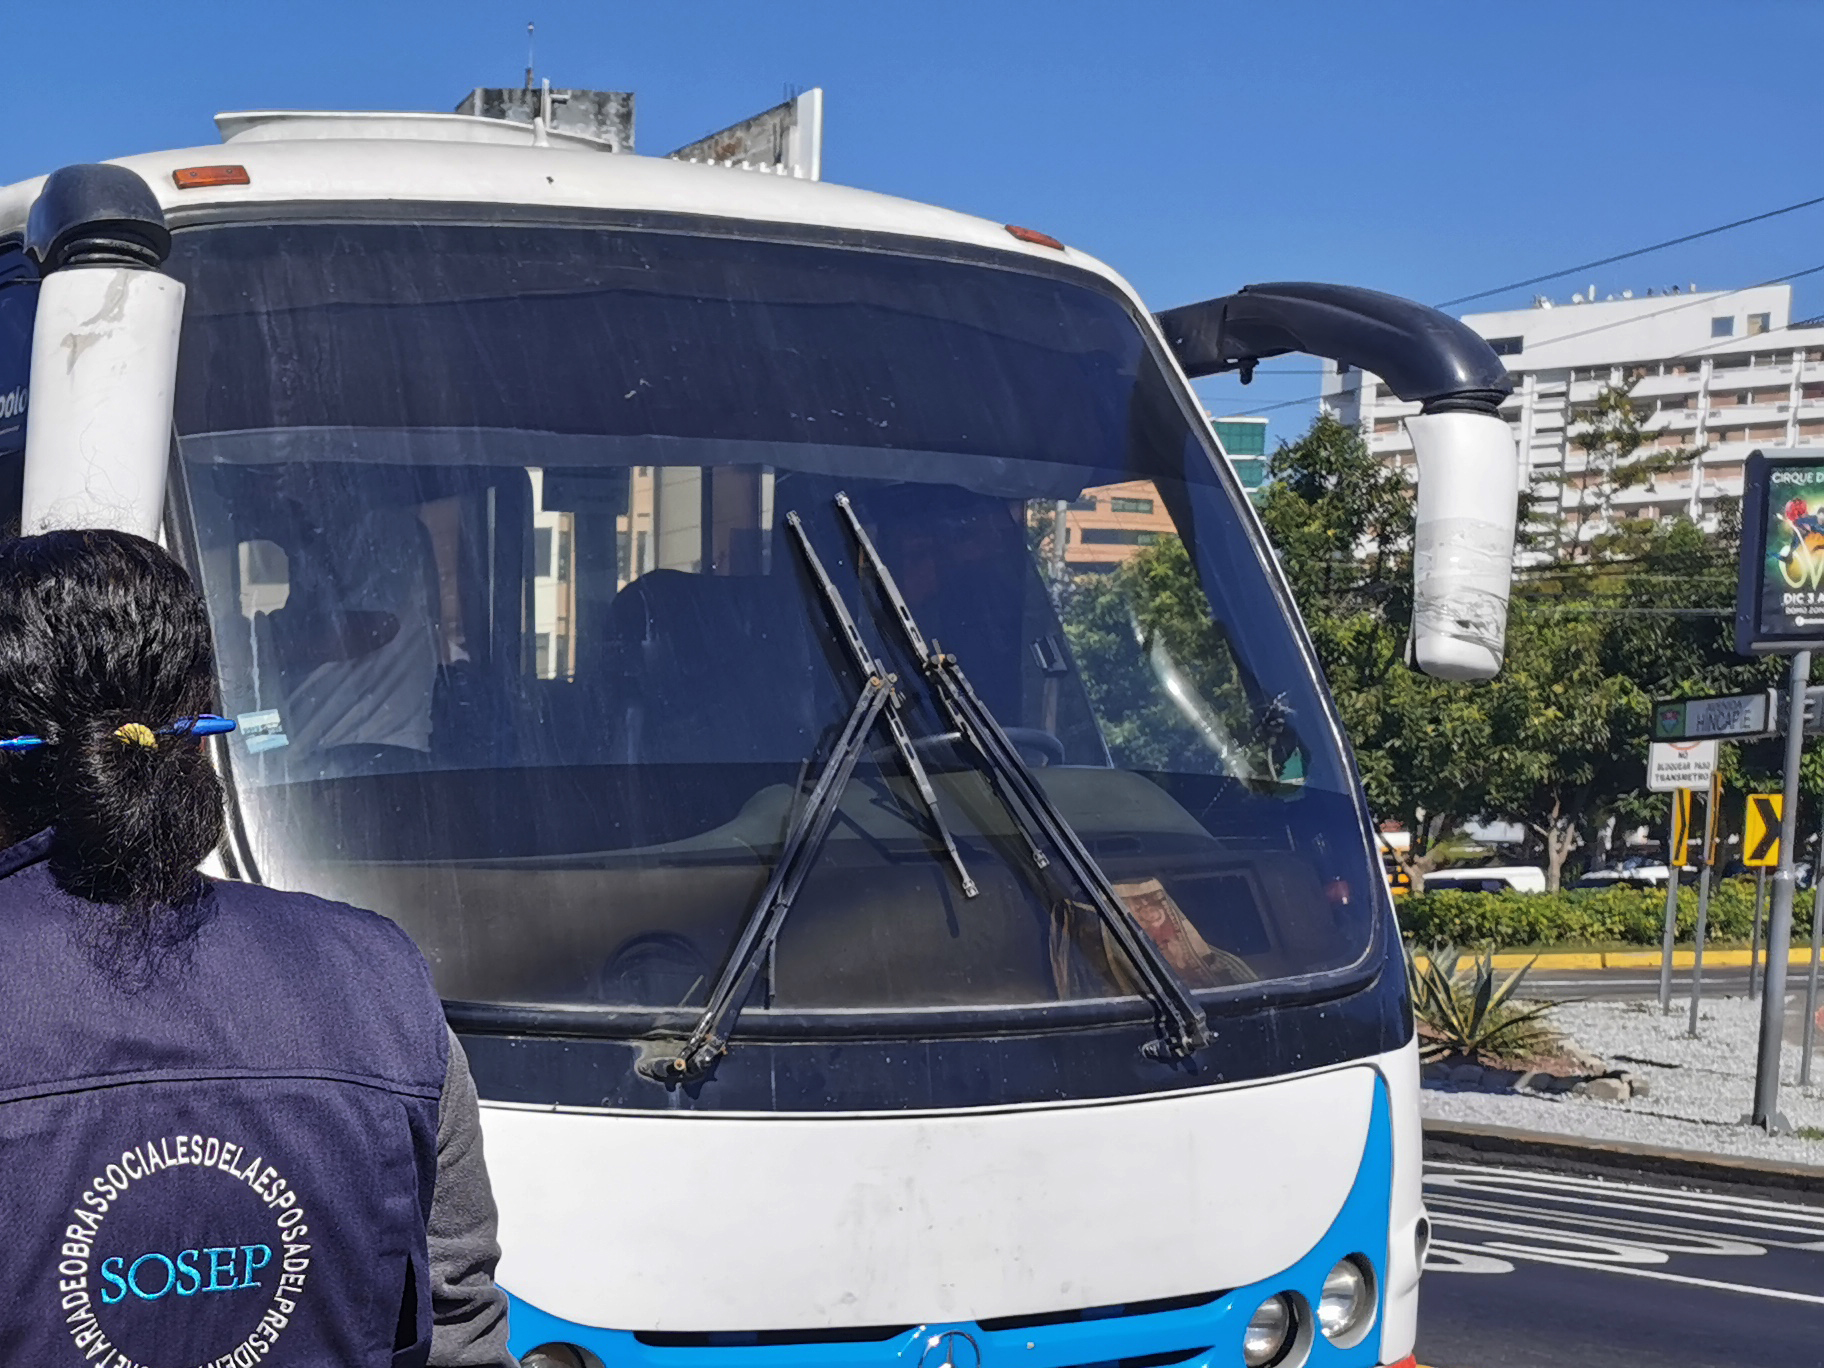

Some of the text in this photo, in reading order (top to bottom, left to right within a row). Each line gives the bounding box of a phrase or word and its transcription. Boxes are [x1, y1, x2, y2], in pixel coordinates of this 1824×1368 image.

[1772, 471, 1814, 486] CIRQUE
[1655, 773, 1709, 782] TRANSMETRO
[100, 1243, 272, 1305] SOSEP
